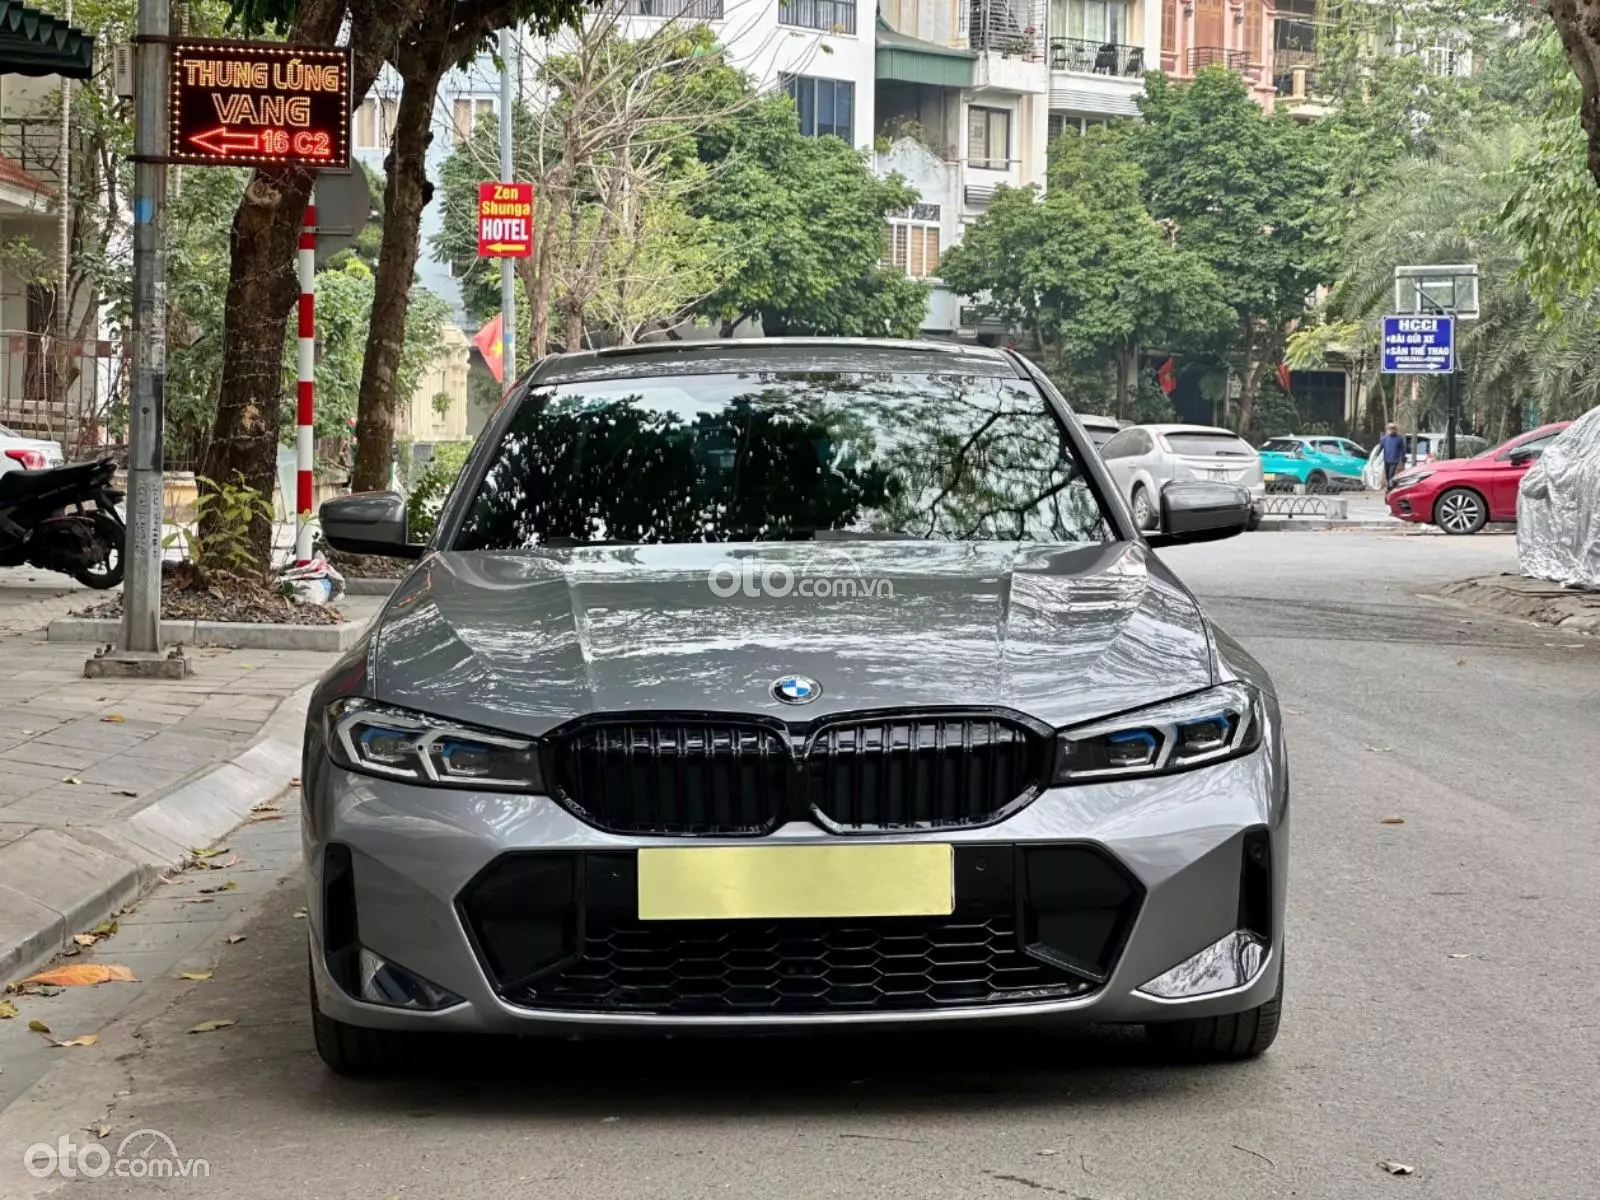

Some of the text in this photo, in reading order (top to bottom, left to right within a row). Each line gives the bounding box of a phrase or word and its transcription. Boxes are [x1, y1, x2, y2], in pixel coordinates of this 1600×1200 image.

[183, 58, 339, 92] THUNG LŨNG
[211, 93, 311, 126] VANG
[261, 129, 330, 155] 16 C2
[494, 185, 519, 201] Zen
[481, 200, 531, 217] Shunga
[481, 218, 529, 241] HOTEL
[1398, 319, 1438, 332] HCCI
[1423, 335, 1436, 344] XE
[1427, 346, 1450, 356] THAO
